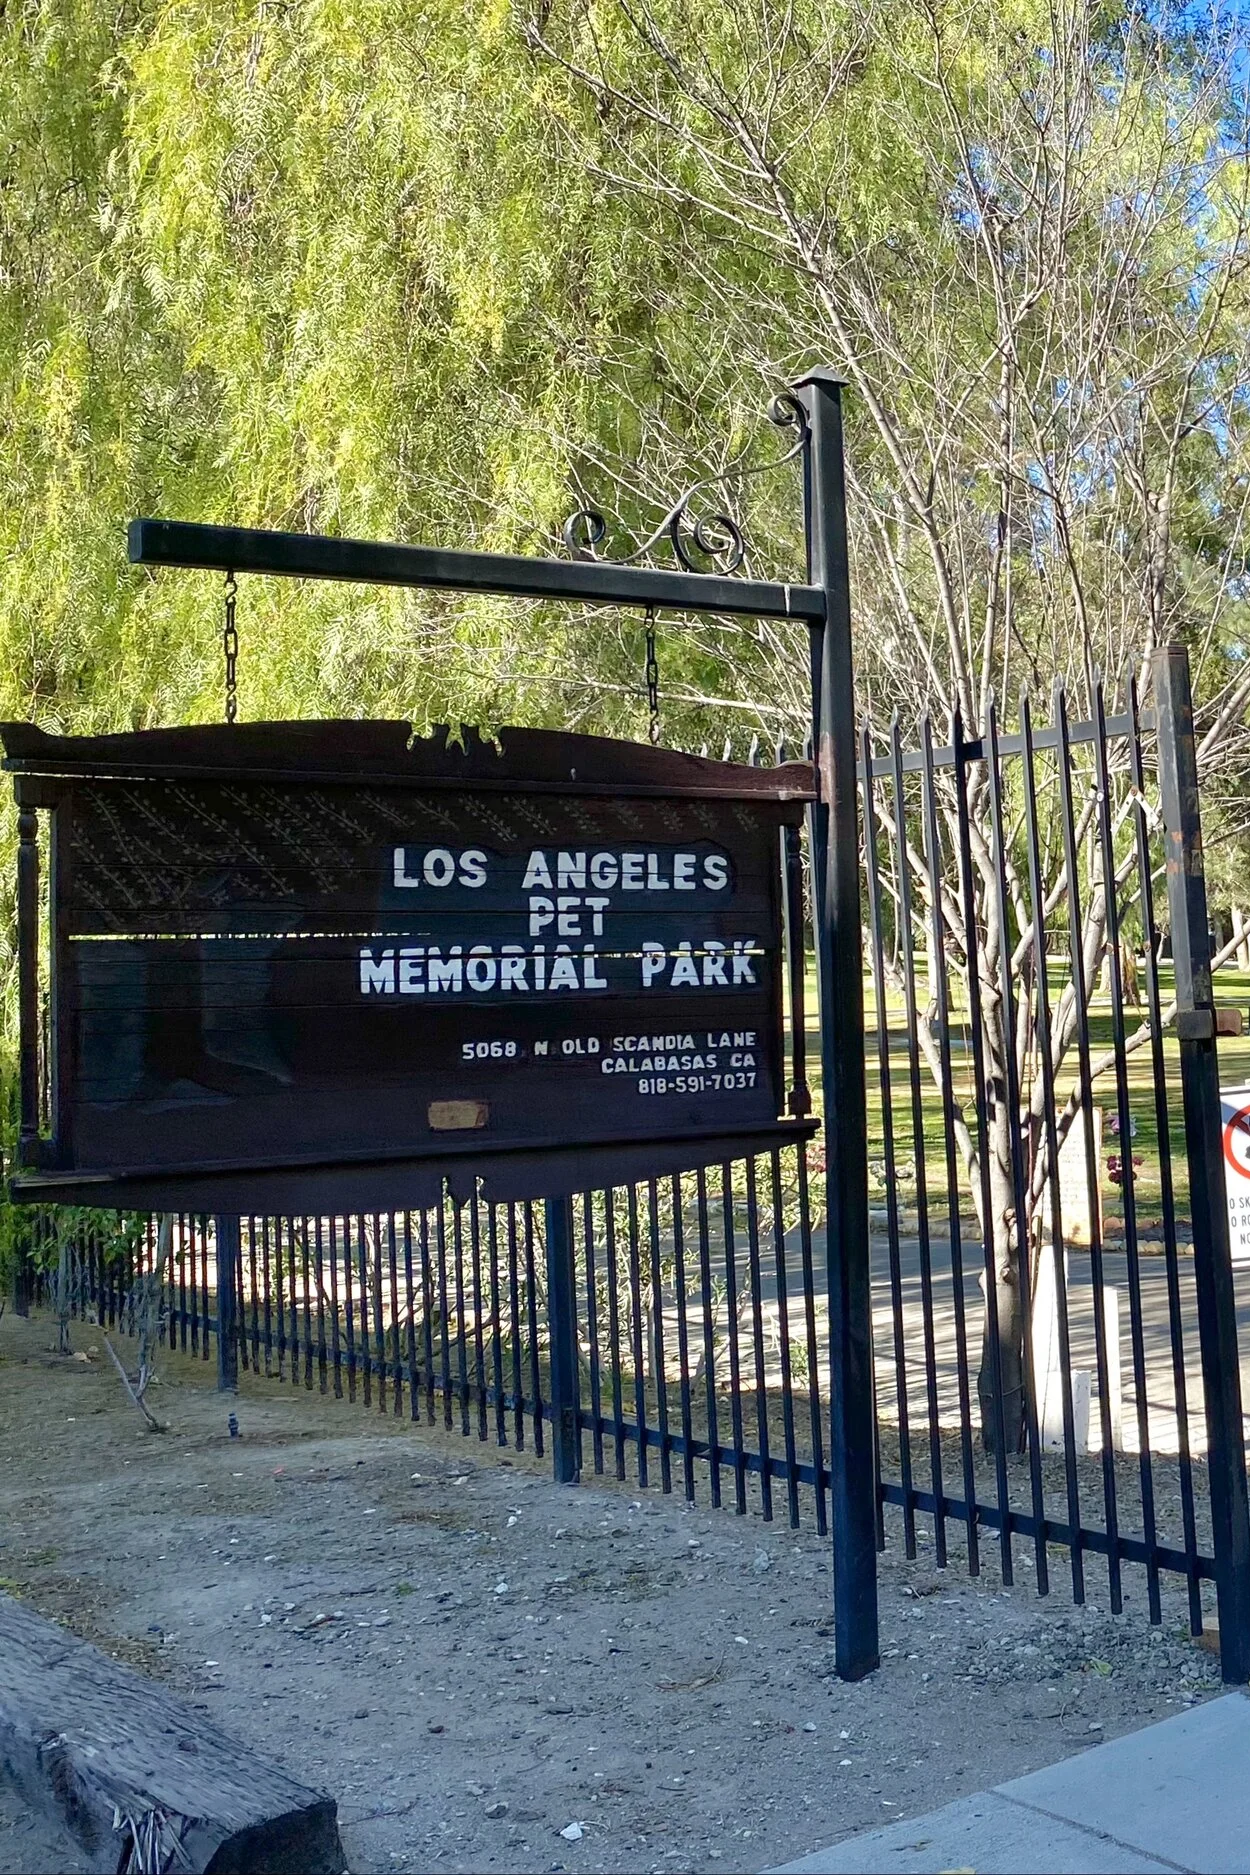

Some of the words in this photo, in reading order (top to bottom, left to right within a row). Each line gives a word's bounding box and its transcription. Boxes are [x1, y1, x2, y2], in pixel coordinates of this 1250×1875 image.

[393, 848, 488, 887] LOS
[521, 850, 728, 890] ANGELES
[529, 896, 610, 936] PET
[359, 944, 607, 993] MEMORIAL
[641, 940, 757, 987] PARK
[462, 1041, 517, 1060] 5068
[534, 1040, 549, 1056] N
[562, 1037, 600, 1055] OLD
[612, 1034, 696, 1052] SCANDIA
[707, 1031, 757, 1048] LANE
[601, 1053, 718, 1074] CALABASAS
[730, 1053, 756, 1067] CA
[638, 1072, 757, 1094] 818-591-7037
